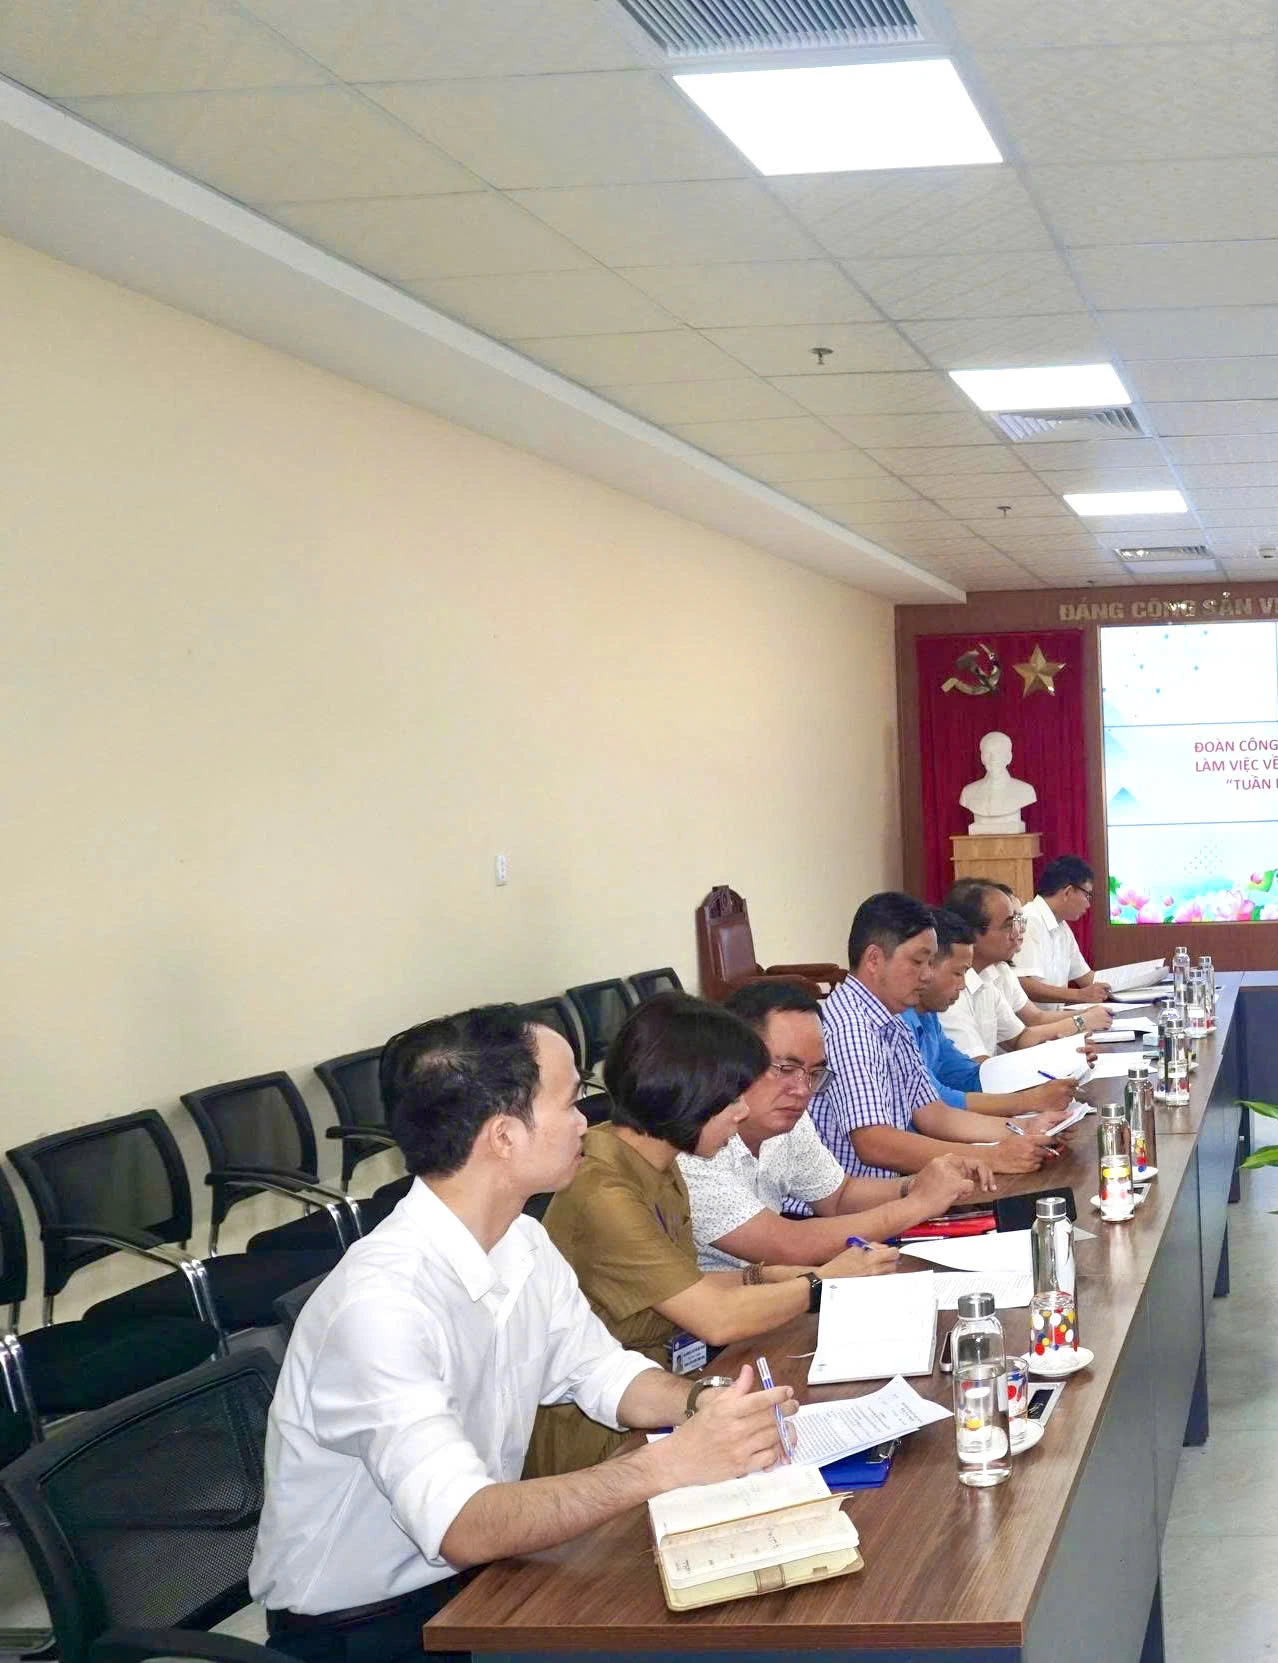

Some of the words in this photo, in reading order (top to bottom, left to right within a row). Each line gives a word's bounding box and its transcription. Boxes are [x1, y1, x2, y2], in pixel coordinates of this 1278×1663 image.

[1193, 738, 1235, 752] ĐOÀN
[1239, 736, 1278, 751] CÔNG
[1195, 757, 1225, 772] LÀM
[1229, 756, 1259, 772] VIỆC
